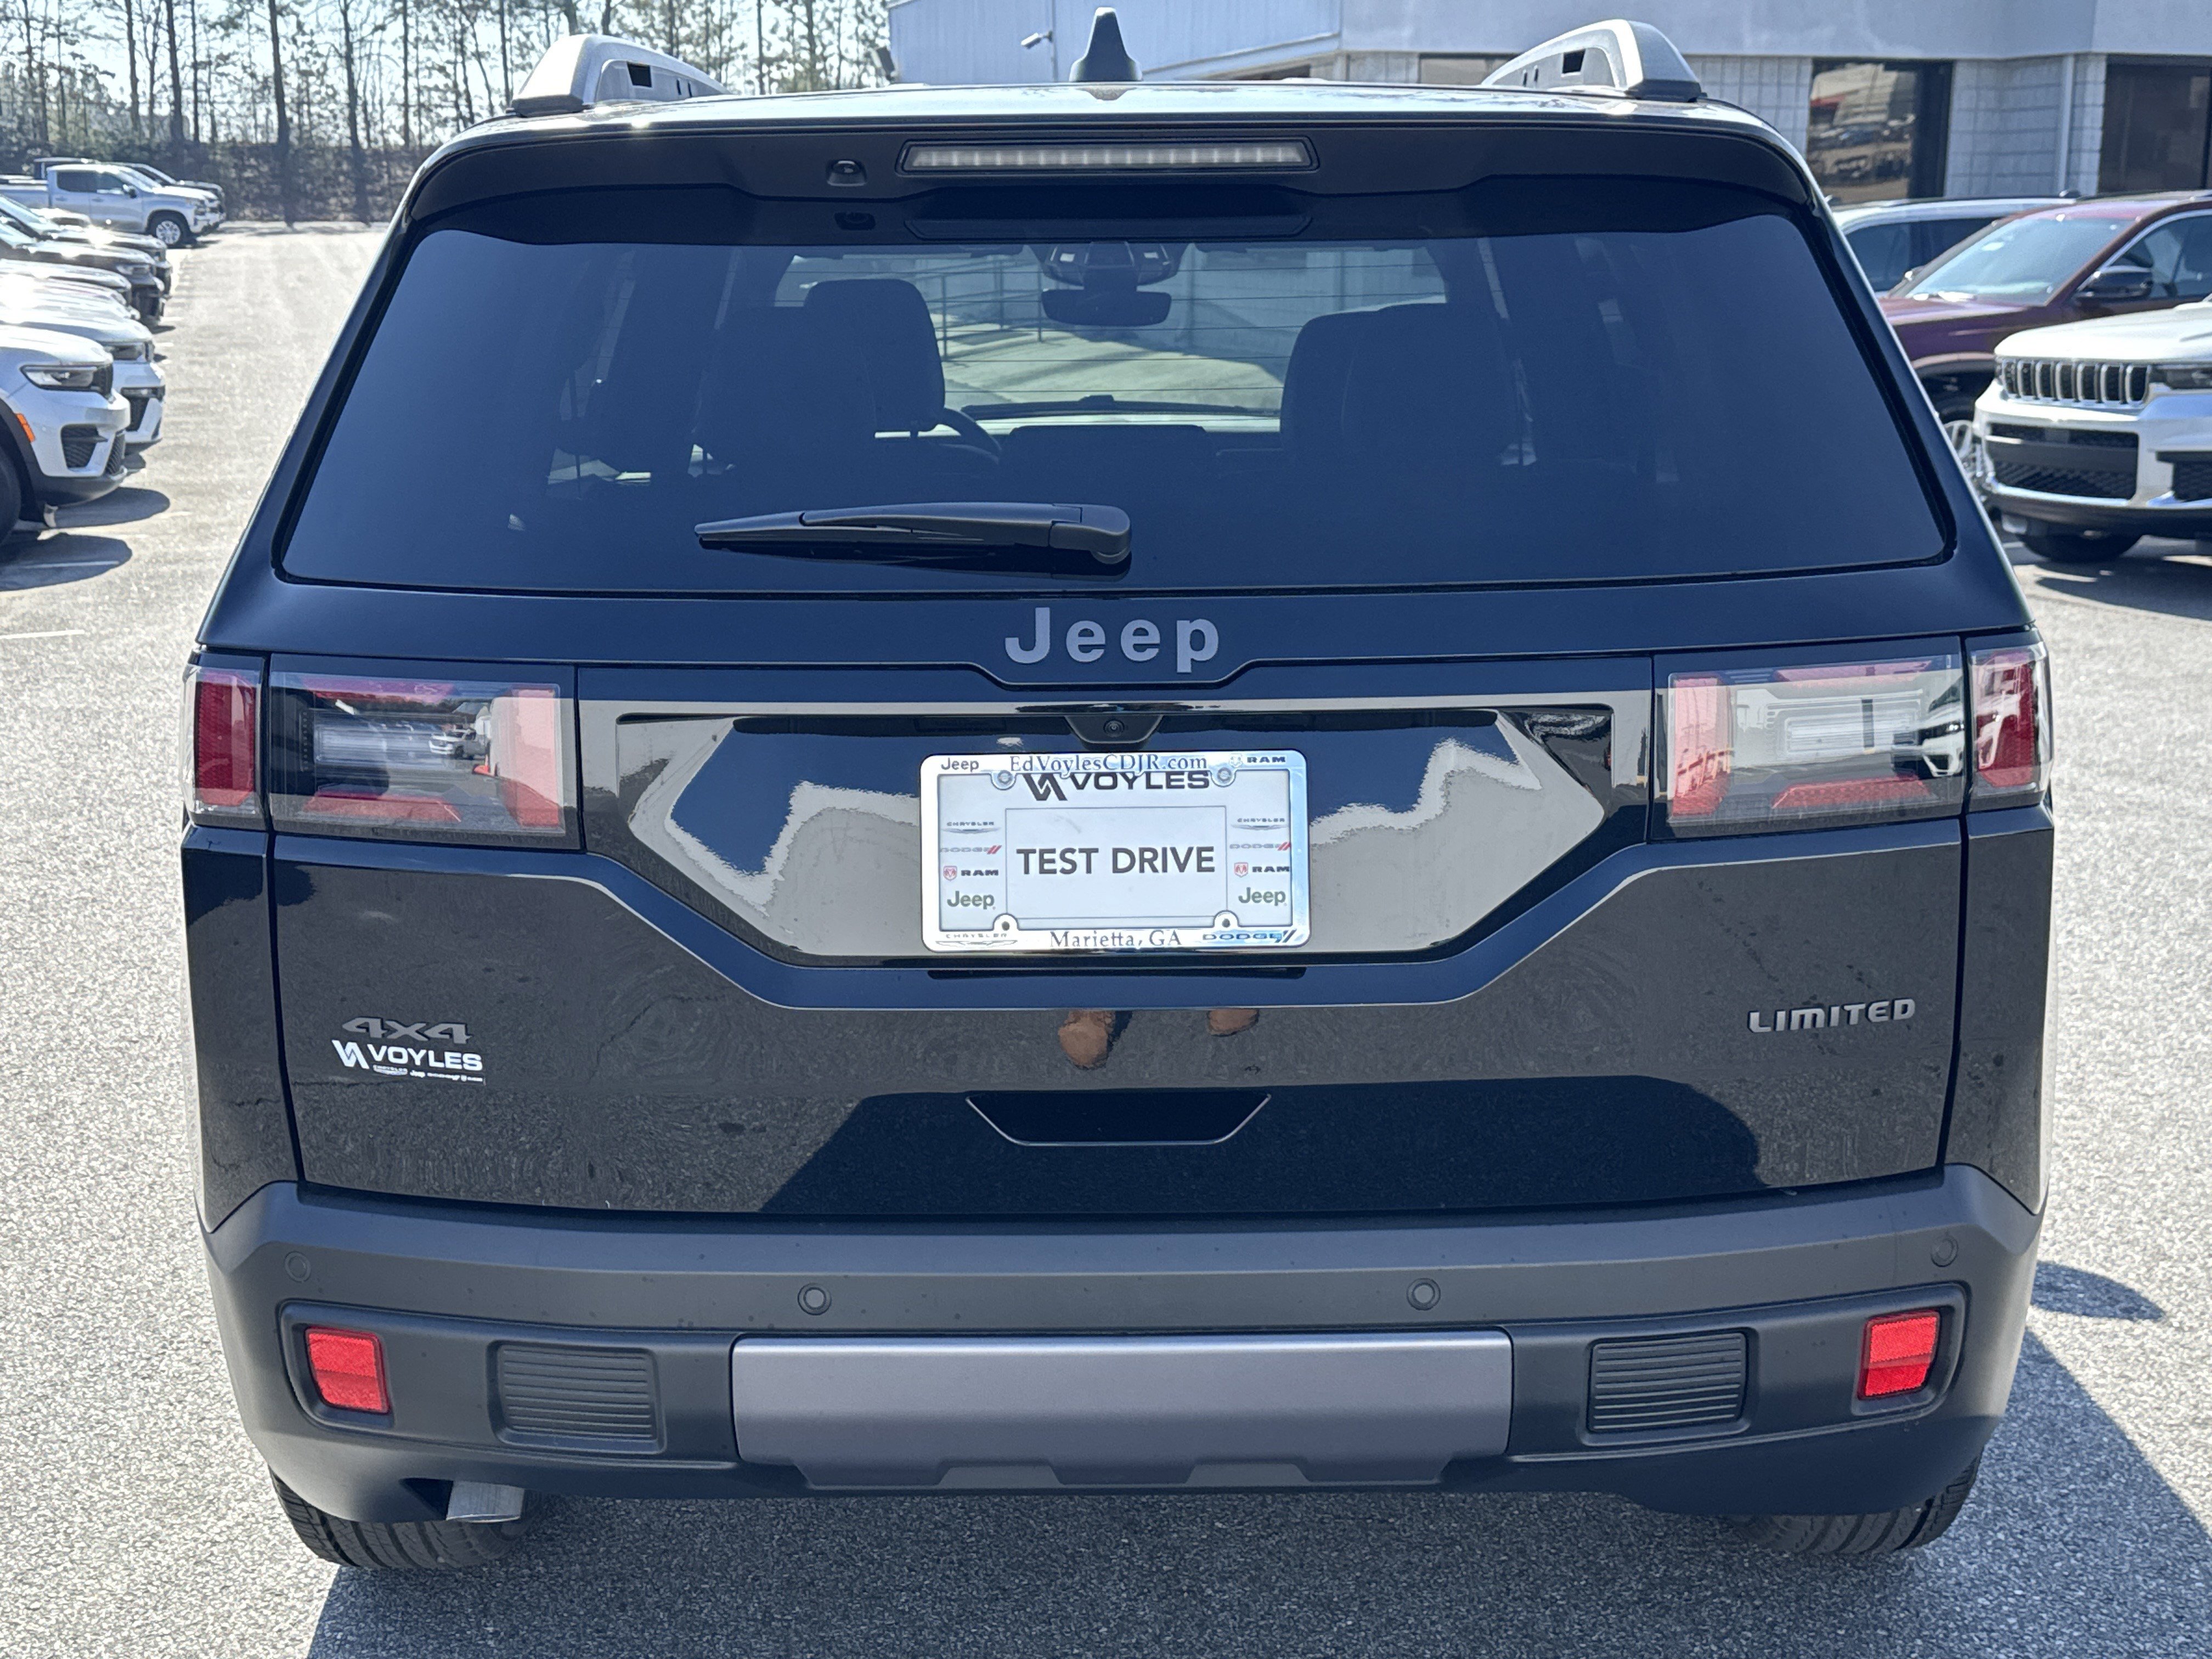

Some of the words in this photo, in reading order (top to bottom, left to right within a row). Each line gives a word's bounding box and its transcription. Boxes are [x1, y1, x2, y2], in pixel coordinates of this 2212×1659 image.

[1005, 607, 1218, 673] Jeep
[941, 758, 979, 772] Jeep
[1010, 754, 1207, 776] EdVoylesCDJR.com
[1070, 770, 1210, 790] VOYLES
[1016, 848, 1099, 874] TEST
[1112, 847, 1215, 873] DRIVE
[947, 890, 995, 910] Jeep
[1238, 887, 1286, 906] Jeep
[1050, 929, 1143, 947] Marietta,
[1149, 929, 1182, 946] GA
[1747, 998, 1916, 1033] LIMITED
[367, 1044, 483, 1071] VOYLES
